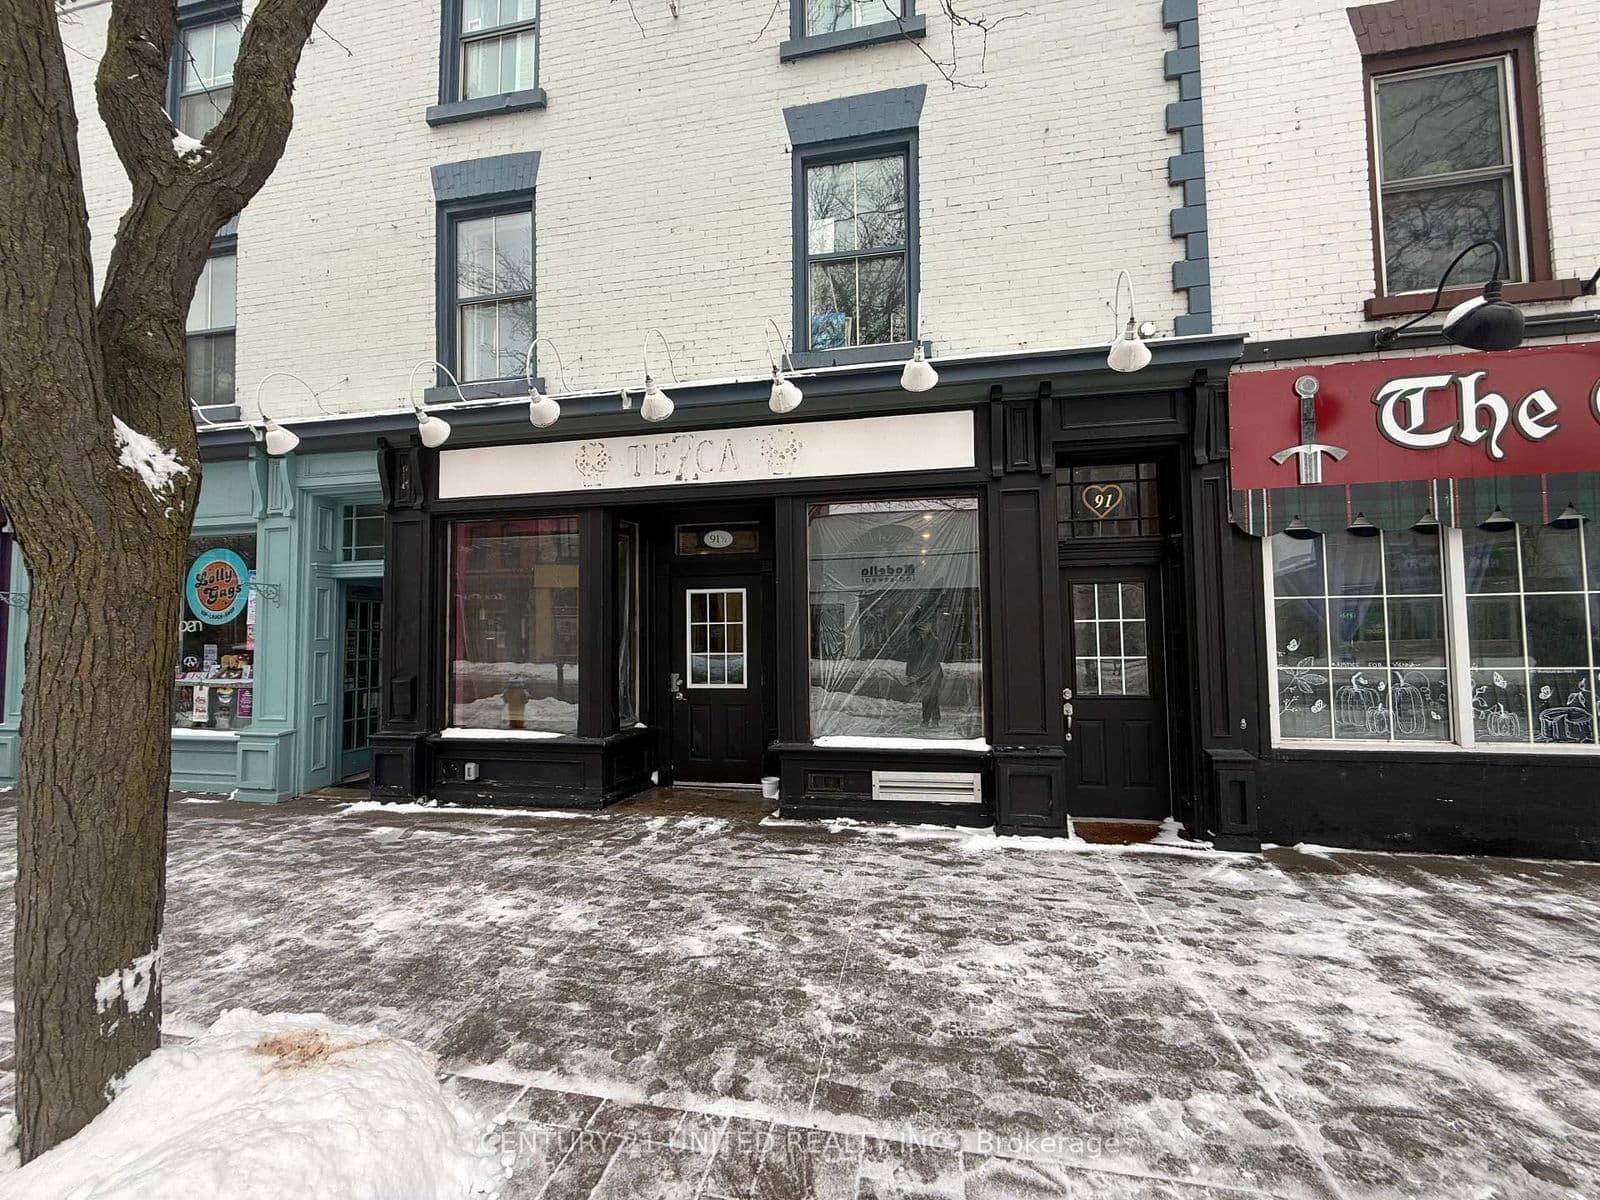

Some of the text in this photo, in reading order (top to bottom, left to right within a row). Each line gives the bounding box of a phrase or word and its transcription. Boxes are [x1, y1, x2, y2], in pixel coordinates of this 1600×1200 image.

[1373, 369, 1561, 460] The
[1095, 494, 1113, 509] 91
[195, 567, 232, 588] Lolly
[204, 584, 242, 604] Gags
[179, 620, 203, 632] pen
